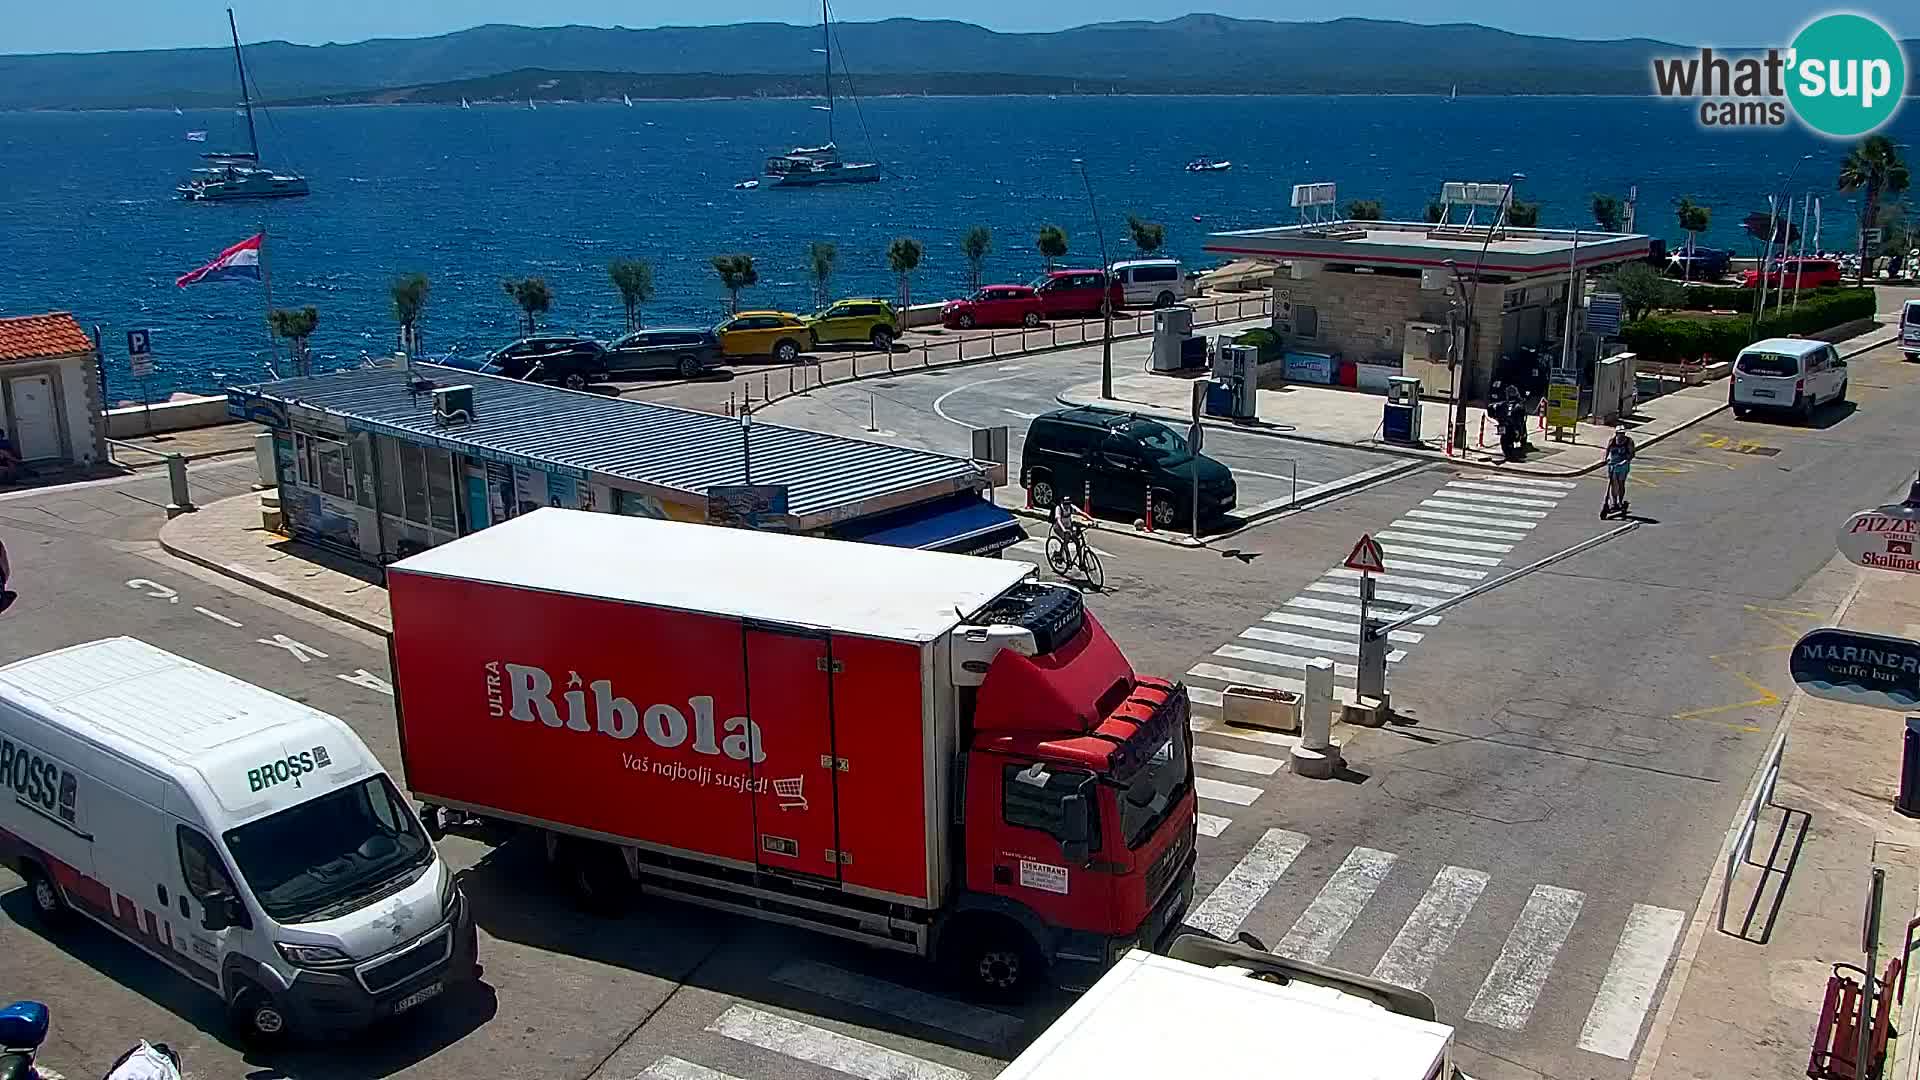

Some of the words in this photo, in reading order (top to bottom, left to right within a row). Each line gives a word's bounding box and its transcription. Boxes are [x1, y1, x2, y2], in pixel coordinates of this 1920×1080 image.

[132, 333, 144, 352] P
[1849, 517, 1920, 536] PIZZE
[1802, 645, 1920, 674] MARINER
[1873, 668, 1899, 681] bar
[485, 660, 503, 717] ULTRA
[505, 663, 767, 763] Ribola
[0, 738, 58, 810] ROSS
[248, 752, 314, 792] BROSS
[622, 752, 649, 772] Vaš
[653, 760, 711, 786] najbolji
